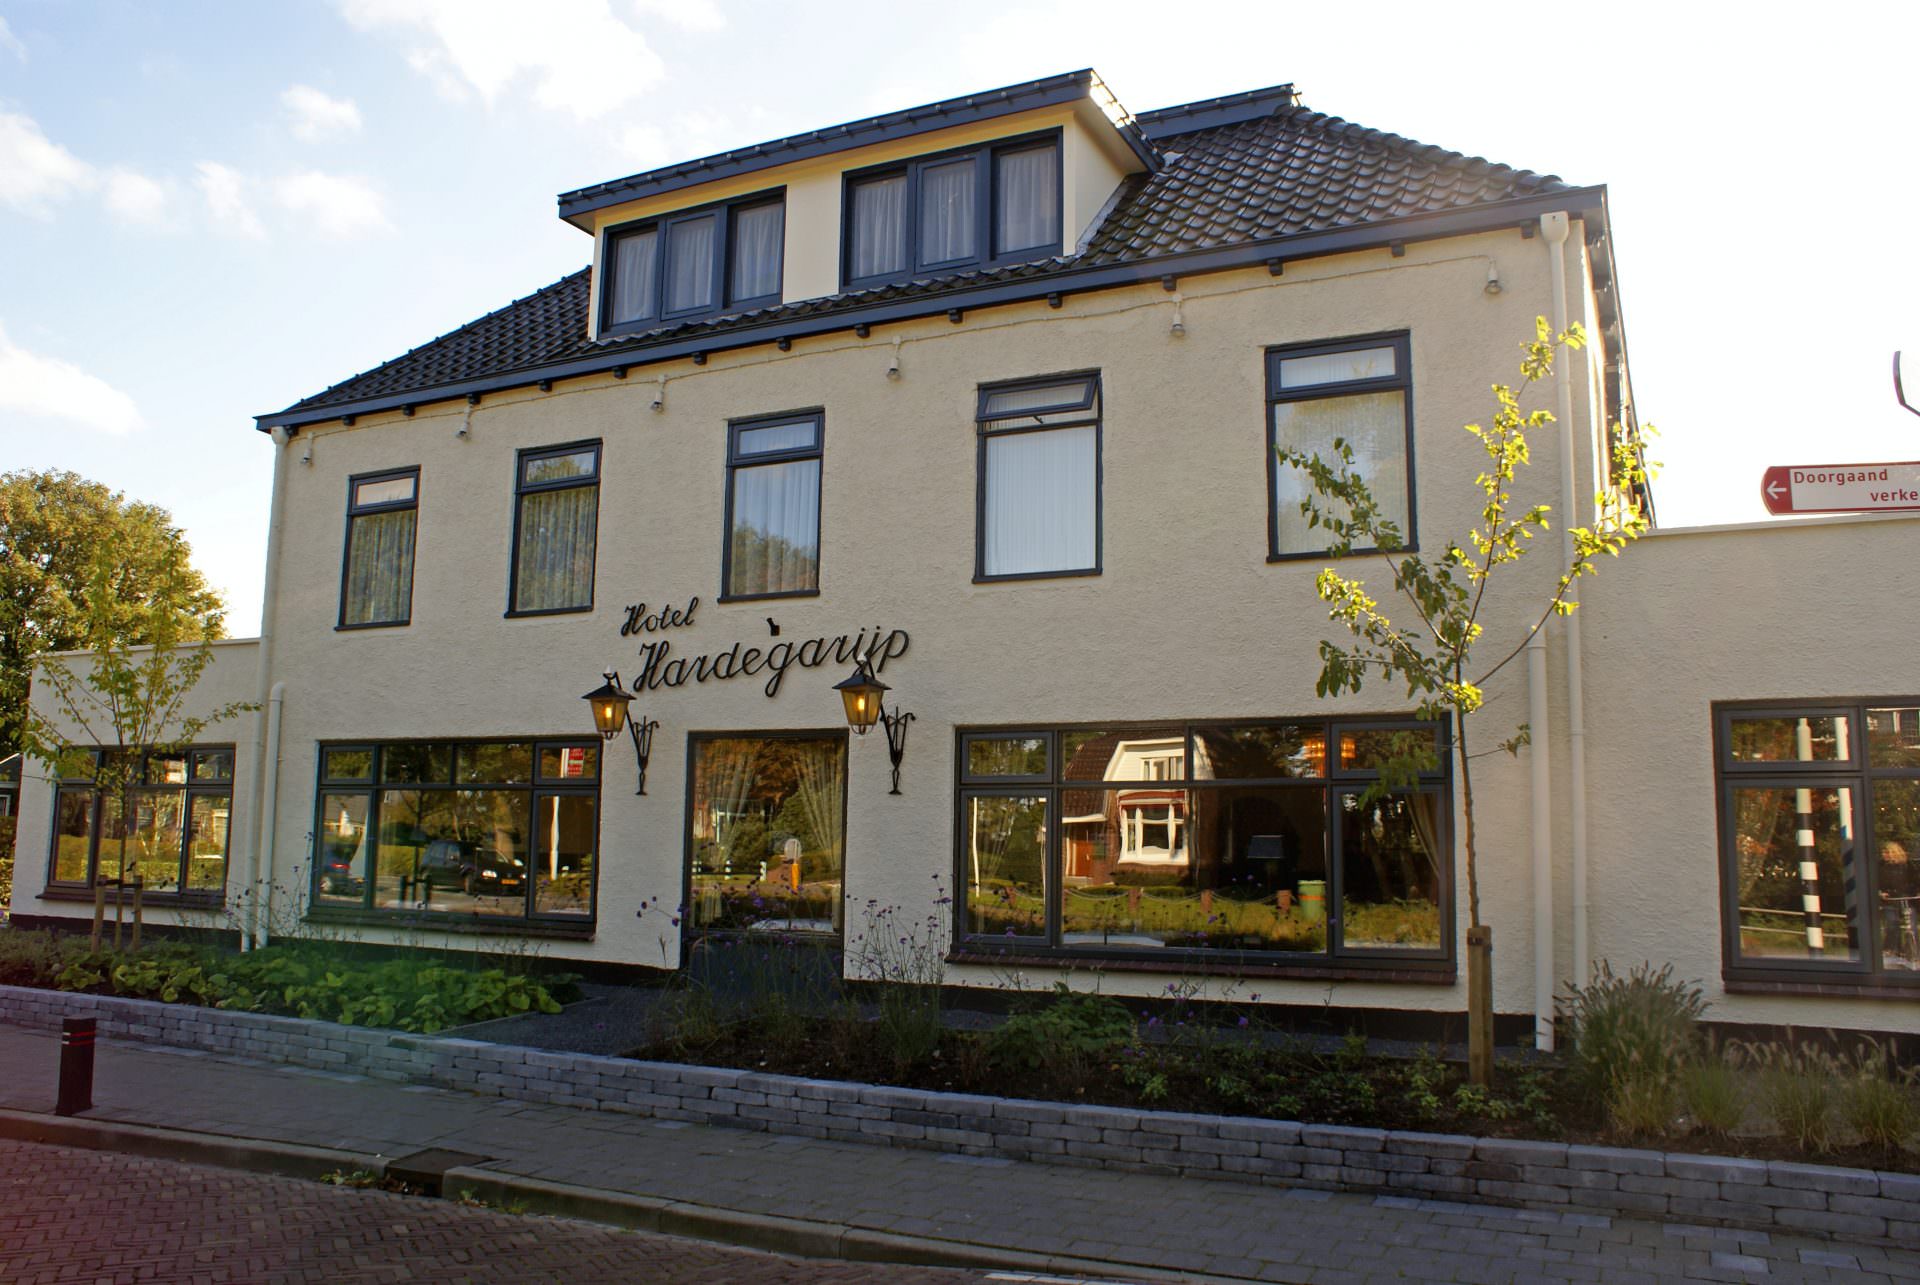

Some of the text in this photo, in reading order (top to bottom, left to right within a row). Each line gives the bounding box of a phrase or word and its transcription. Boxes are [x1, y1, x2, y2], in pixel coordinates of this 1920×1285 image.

[1794, 469, 1888, 485] Doorgaand
[620, 596, 699, 637] Hotel
[633, 625, 911, 698] Hardegarijp
